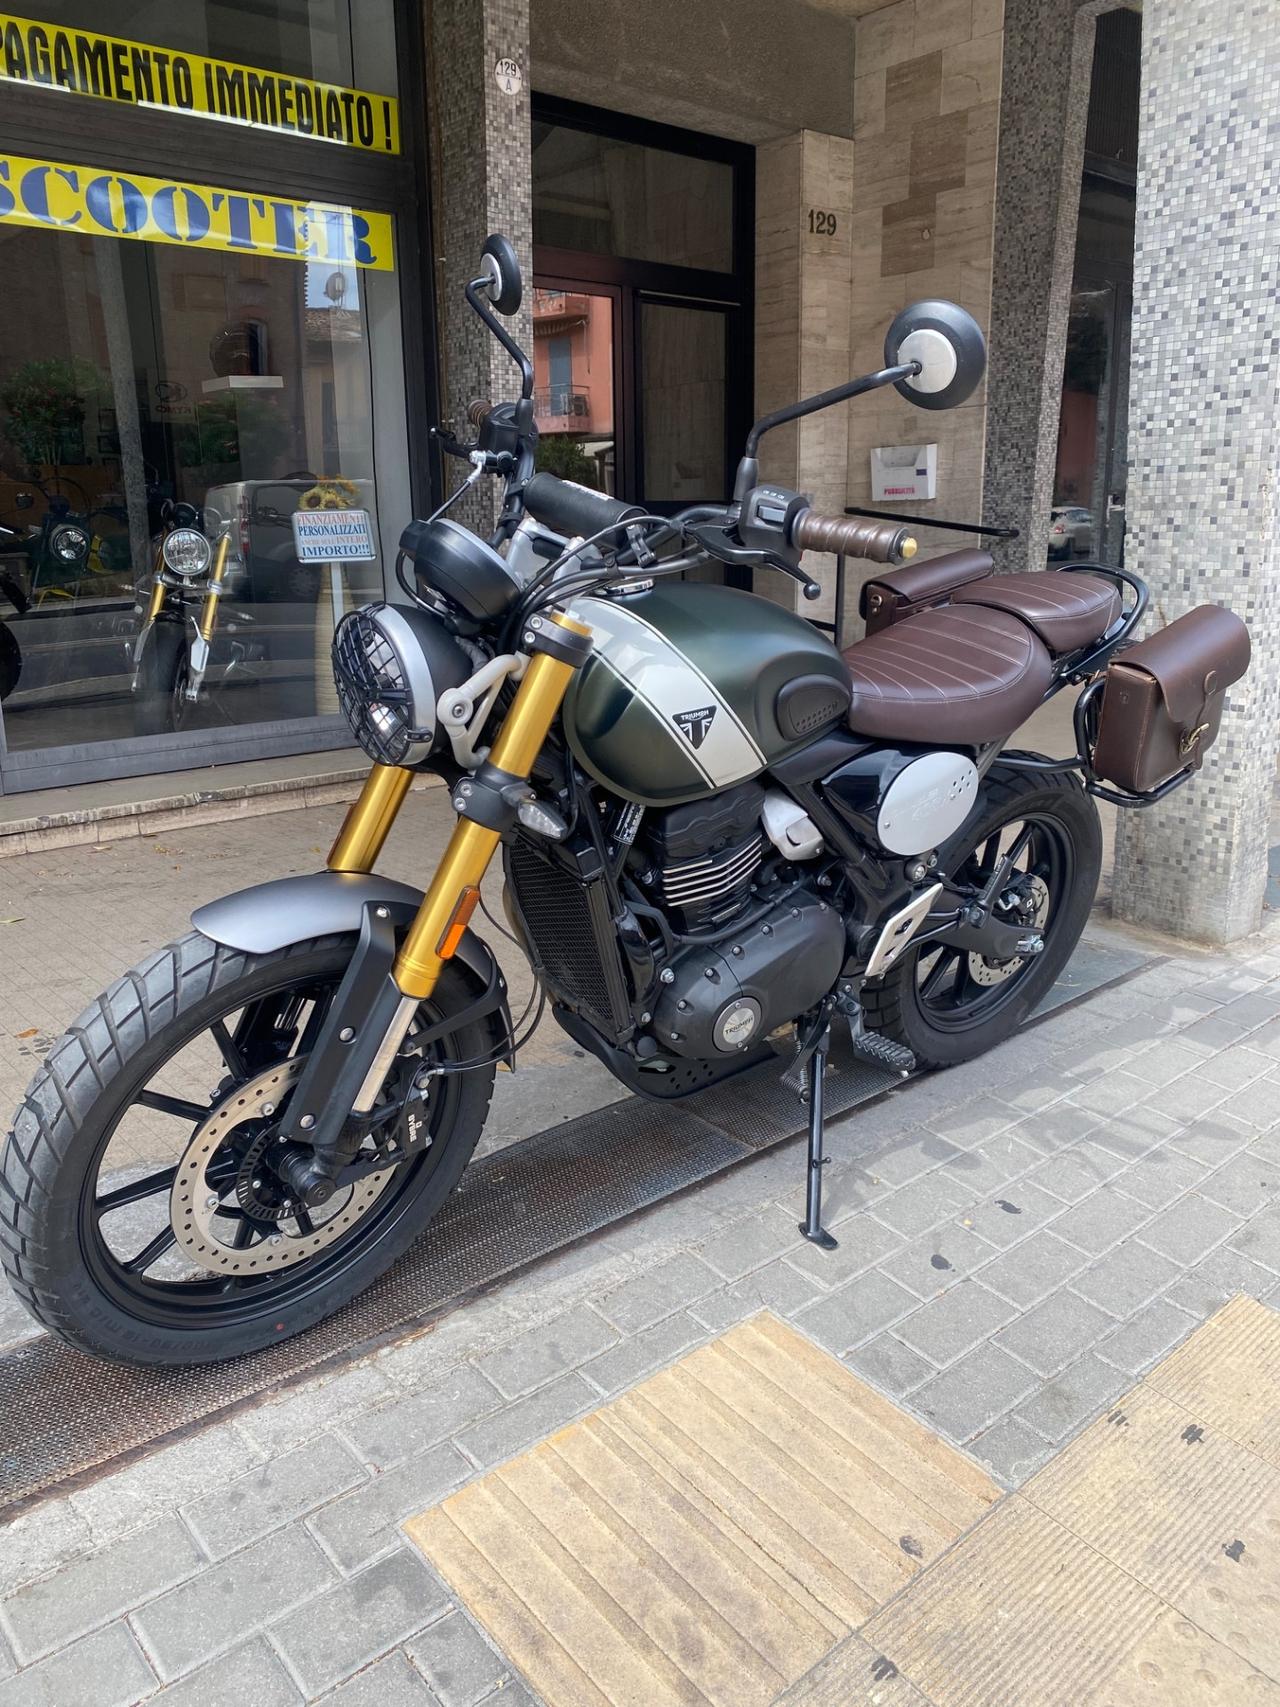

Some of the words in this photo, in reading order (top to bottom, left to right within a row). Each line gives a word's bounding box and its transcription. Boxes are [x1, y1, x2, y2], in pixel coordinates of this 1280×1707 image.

[500, 61, 517, 76] 129
[0, 21, 193, 110] AGAMENTO
[204, 63, 374, 147] IMMEDIATO
[506, 79, 512, 91] A
[808, 209, 837, 236] 129
[298, 524, 366, 536] PERSONALIZZATI
[302, 544, 370, 557] IMPORTO!!!
[681, 709, 709, 720] TRIUMPH
[725, 1016, 753, 1034] TRIUMPH
